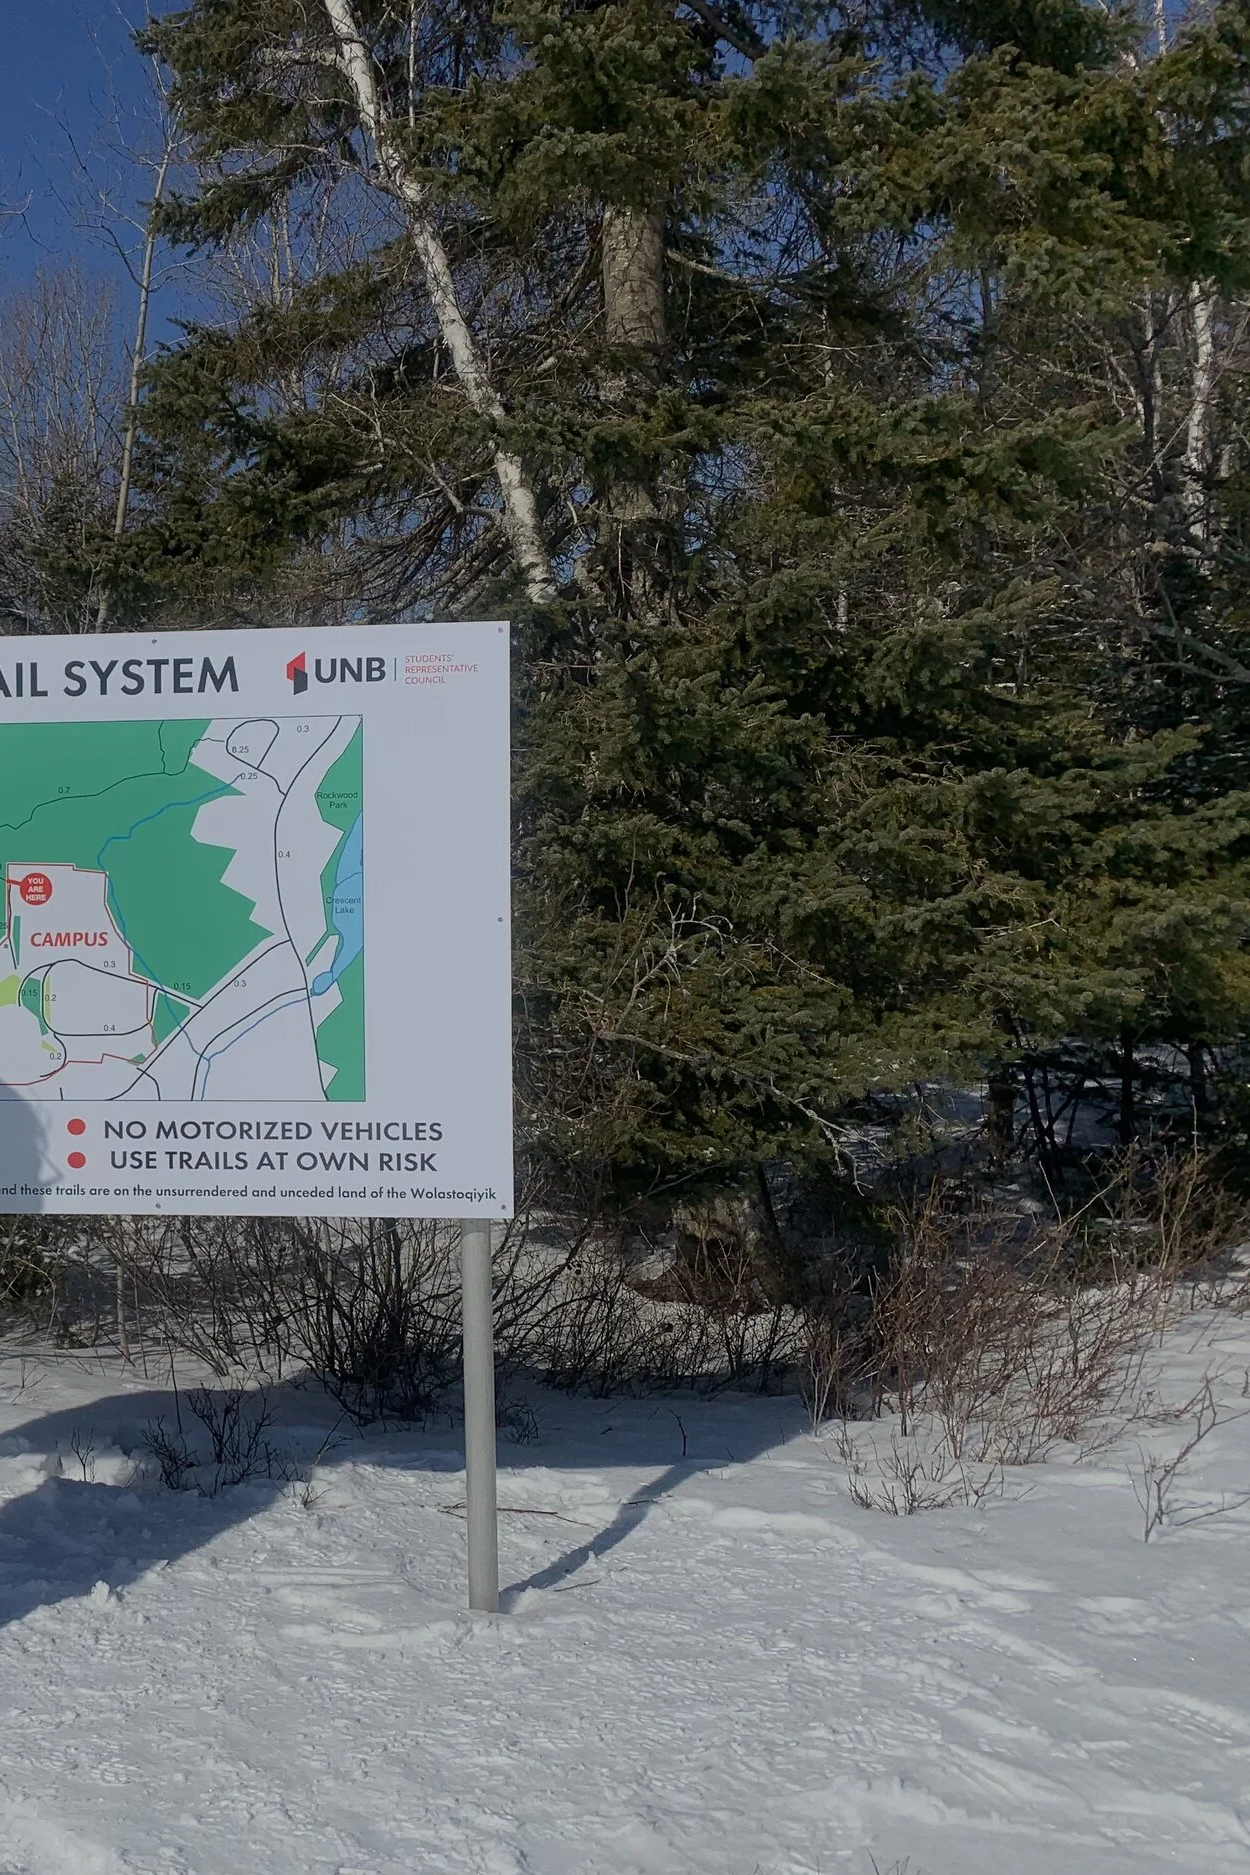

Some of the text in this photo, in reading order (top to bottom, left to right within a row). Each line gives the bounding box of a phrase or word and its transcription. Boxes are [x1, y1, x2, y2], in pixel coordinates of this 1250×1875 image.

[315, 657, 386, 683] UNB
[405, 664, 479, 674] REPRESENTATIVE
[63, 656, 239, 697] SYSTEM
[405, 676, 446, 684] COUNCIL
[297, 725, 310, 733] 0.3
[316, 791, 358, 799] Rockwood
[335, 906, 354, 914] Lake
[31, 932, 108, 947] CAMPUS
[104, 1024, 115, 1032] 0.4
[104, 1120, 443, 1141] NO MOTORIZED VEHICLES
[110, 1150, 438, 1172] USE TRAILS AT OWN RISK
[20, 1184, 52, 1195] these
[56, 1184, 86, 1196] trails
[89, 1188, 110, 1196] are
[114, 1188, 129, 1196] on
[133, 1185, 152, 1196] the
[156, 1185, 248, 1197] unsurrendered
[252, 1185, 276, 1197] and
[280, 1186, 334, 1198] unceded
[338, 1186, 366, 1198] land
[370, 1187, 384, 1198] of
[387, 1187, 406, 1199] the
[411, 1187, 497, 1202] Wolastoqiyik
